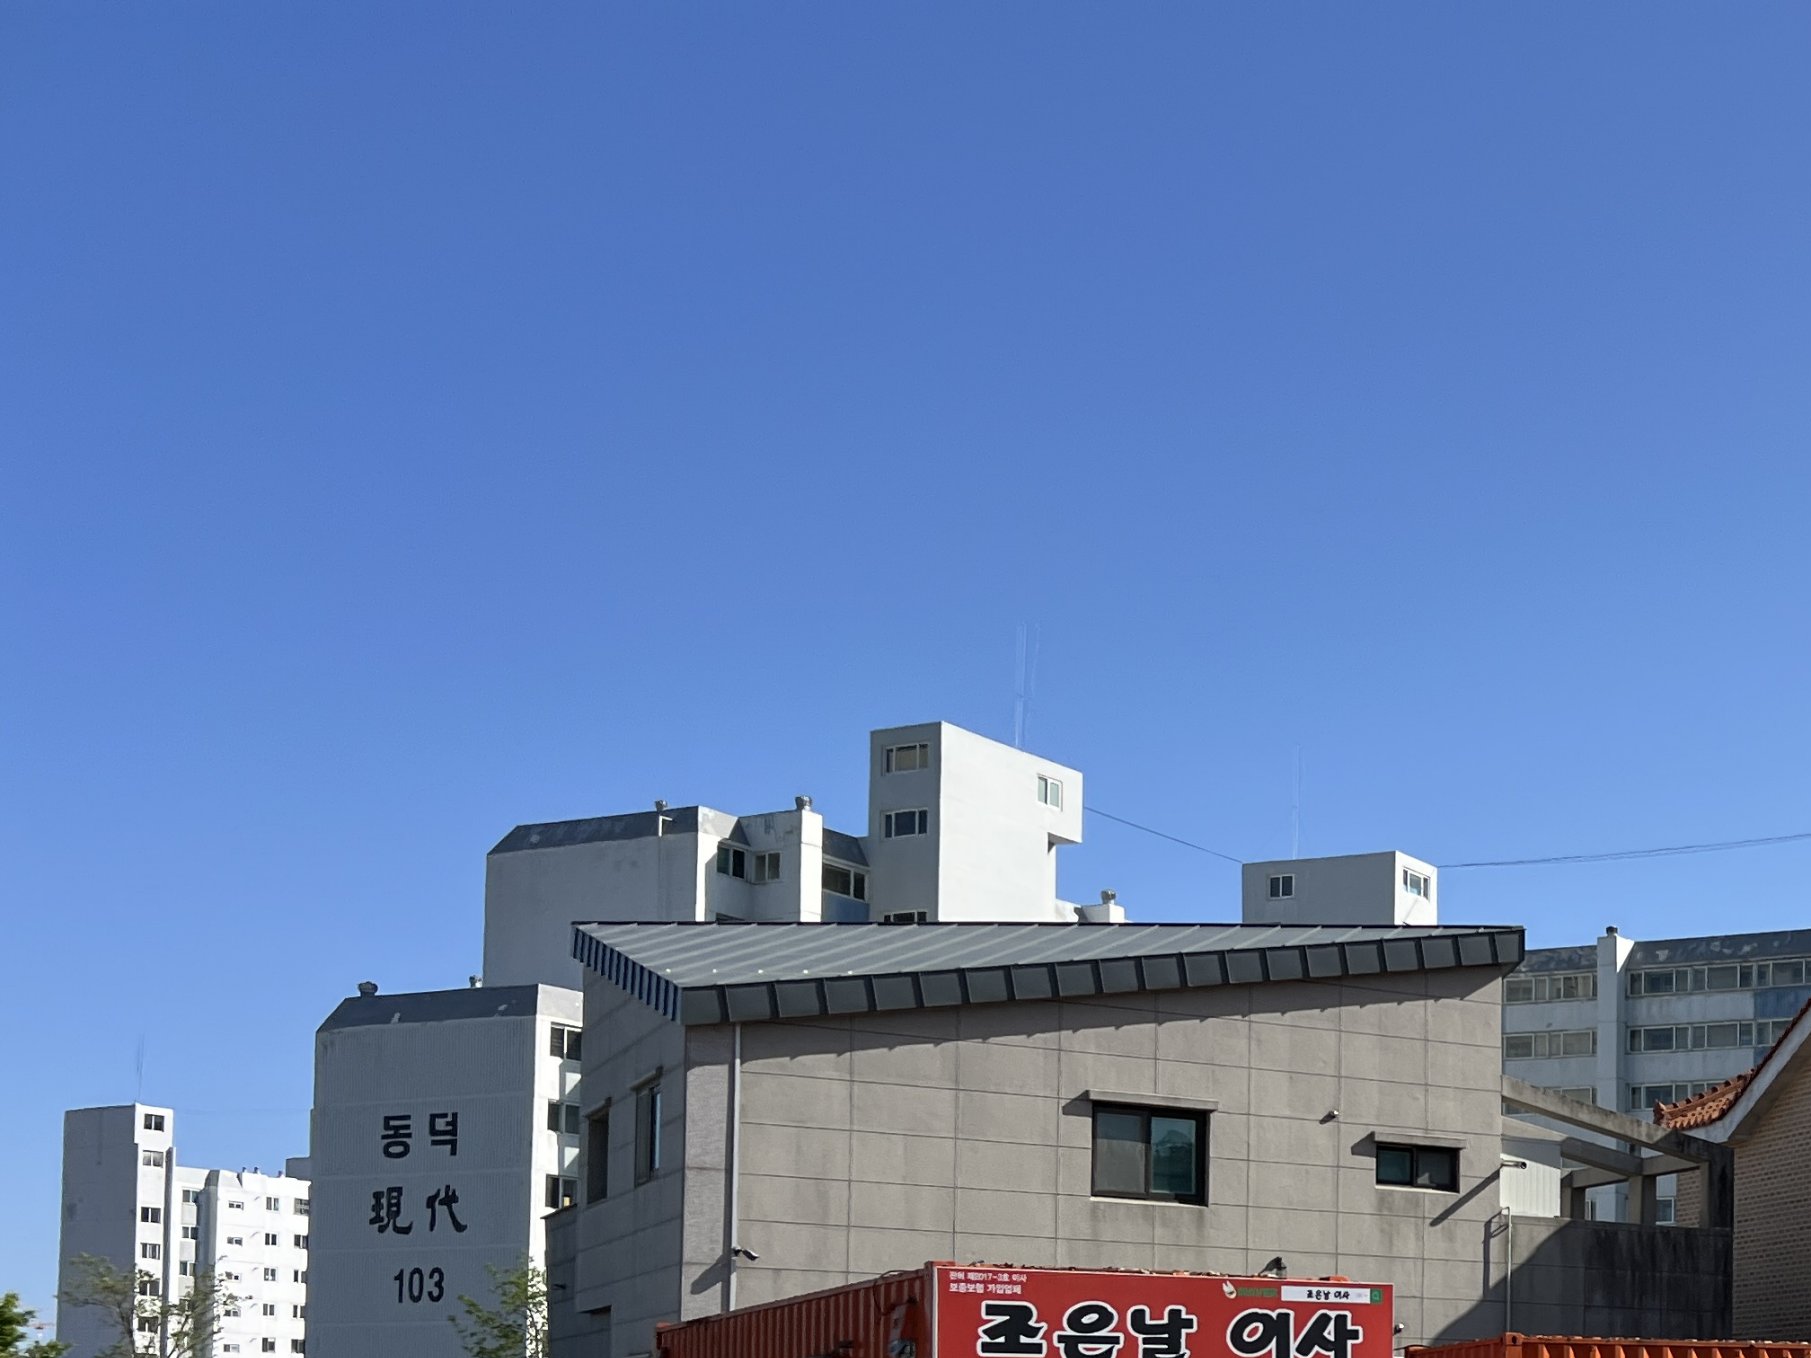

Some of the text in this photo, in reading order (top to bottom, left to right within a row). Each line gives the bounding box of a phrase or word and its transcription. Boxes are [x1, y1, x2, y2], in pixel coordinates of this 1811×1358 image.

[380, 1111, 459, 1159] 동덕
[368, 1184, 468, 1235] 現代
[393, 1266, 445, 1304] 103
